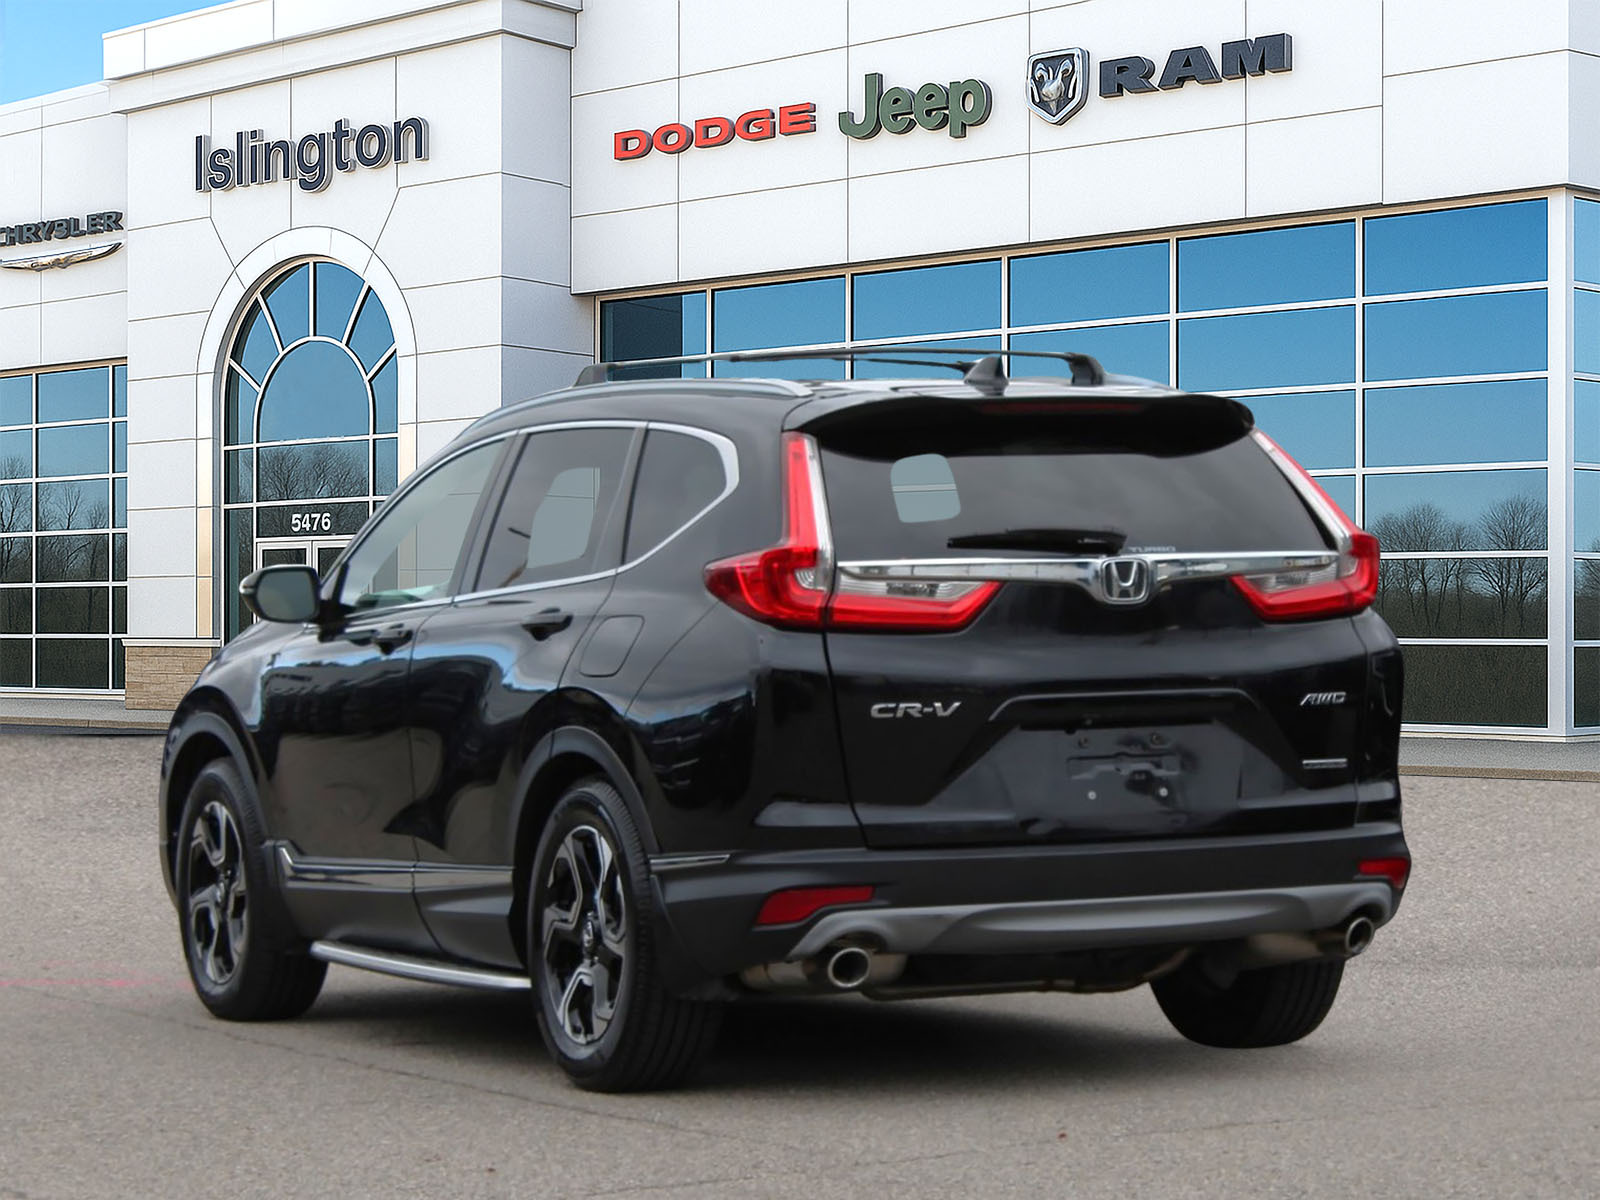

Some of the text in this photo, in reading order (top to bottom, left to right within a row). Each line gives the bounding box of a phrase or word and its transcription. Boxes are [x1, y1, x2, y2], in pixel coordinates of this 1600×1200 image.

[1099, 32, 1293, 98] RAM
[613, 102, 817, 161] DODGE
[838, 72, 993, 139] Jeep
[194, 115, 430, 193] Islington
[291, 512, 332, 532] 5476
[870, 701, 962, 719] CR-V
